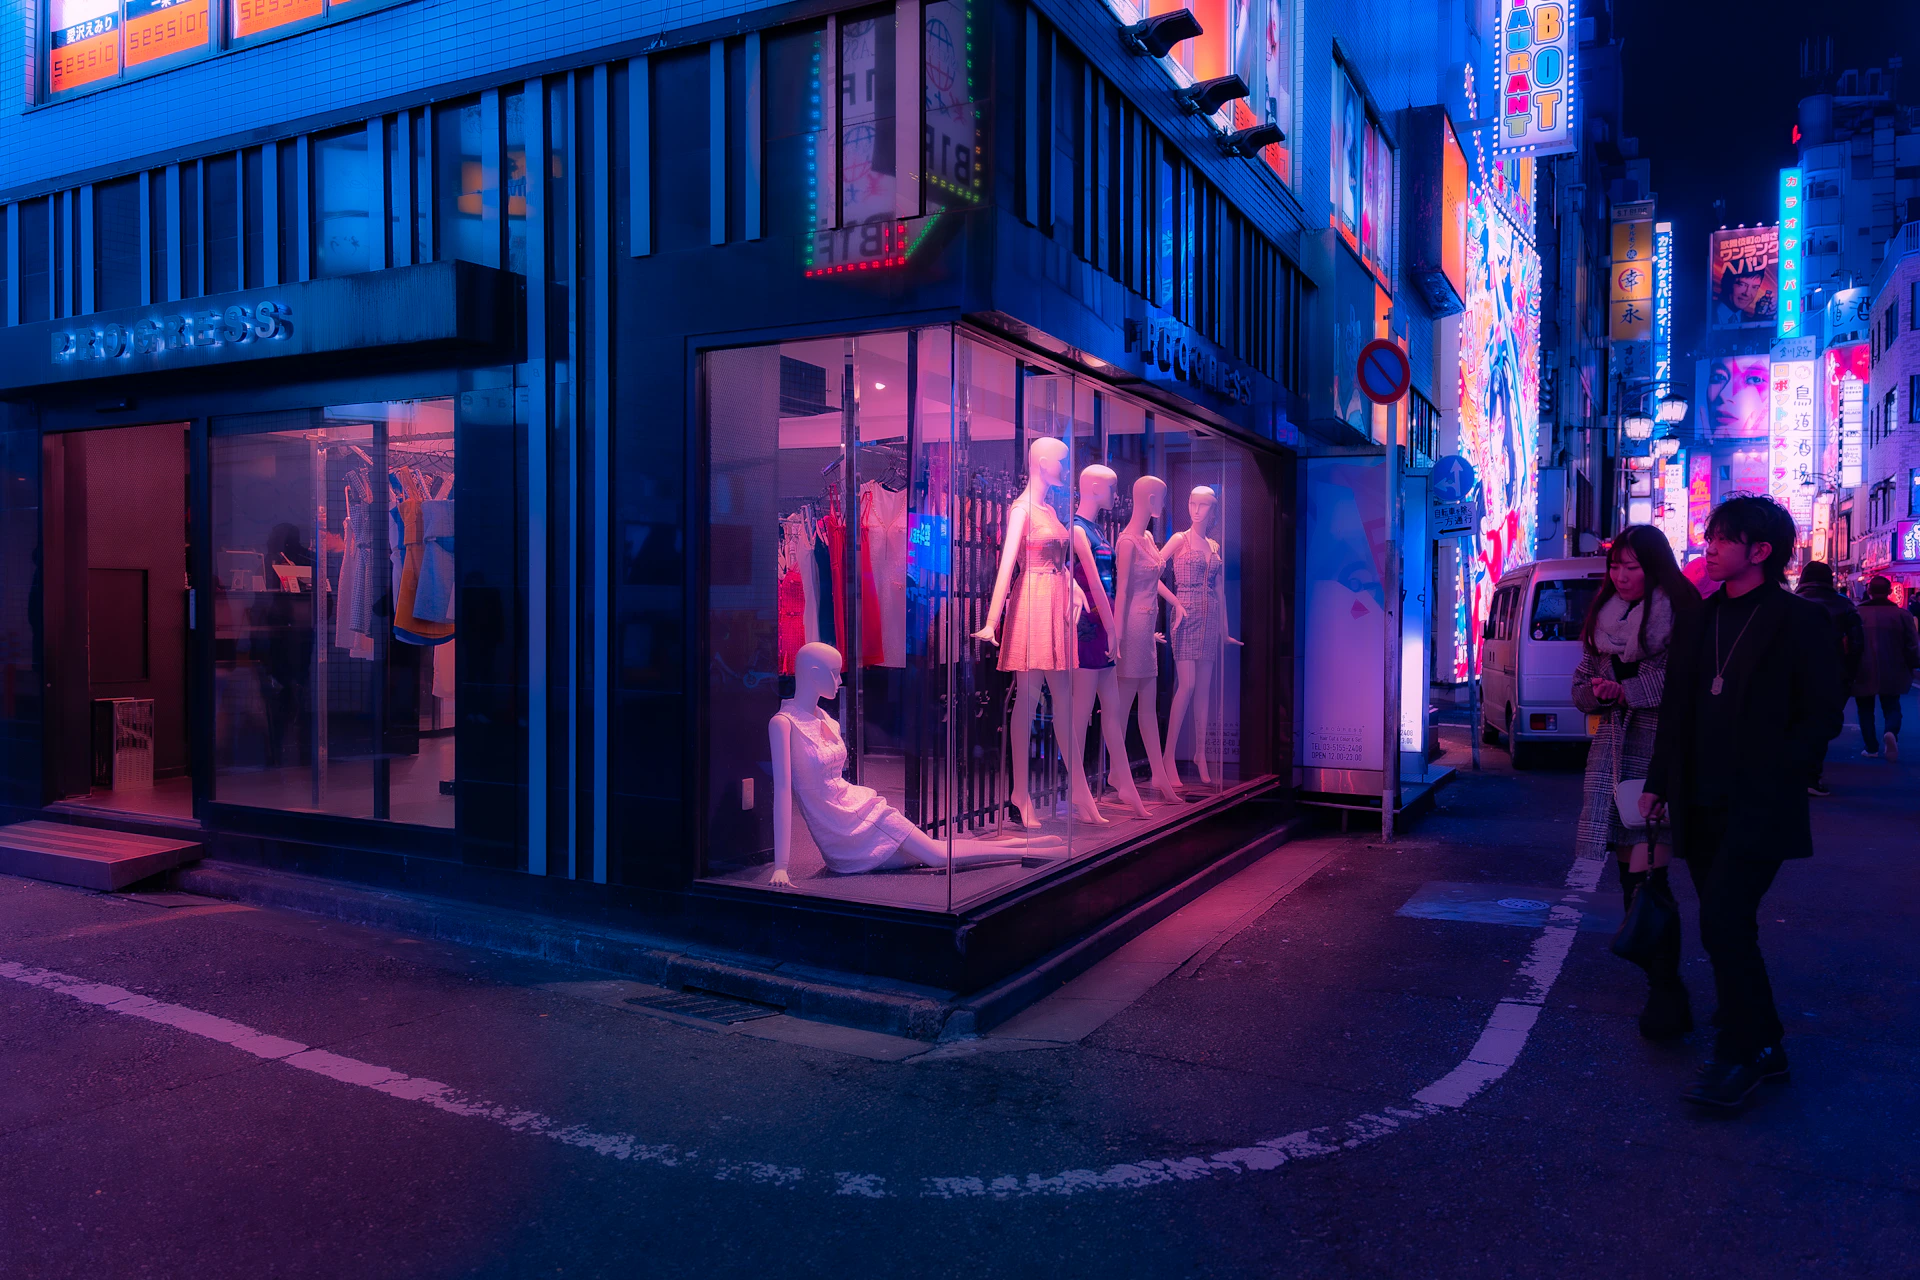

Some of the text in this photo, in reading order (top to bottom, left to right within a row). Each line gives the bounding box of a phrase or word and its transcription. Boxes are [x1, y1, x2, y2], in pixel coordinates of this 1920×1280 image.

[66, 16, 113, 45] 愛沢えみり
[130, 11, 208, 50] session
[54, 41, 118, 78] sessio
[1620, 303, 1644, 325] 永
[51, 301, 280, 365] PROGRESS
[1772, 364, 1790, 496] ロボットレストラン
[1434, 505, 1472, 518] 自転車を除く
[1434, 516, 1472, 527] 一方通行
[1311, 742, 1321, 751] TEL
[1311, 751, 1327, 760] OPEN
